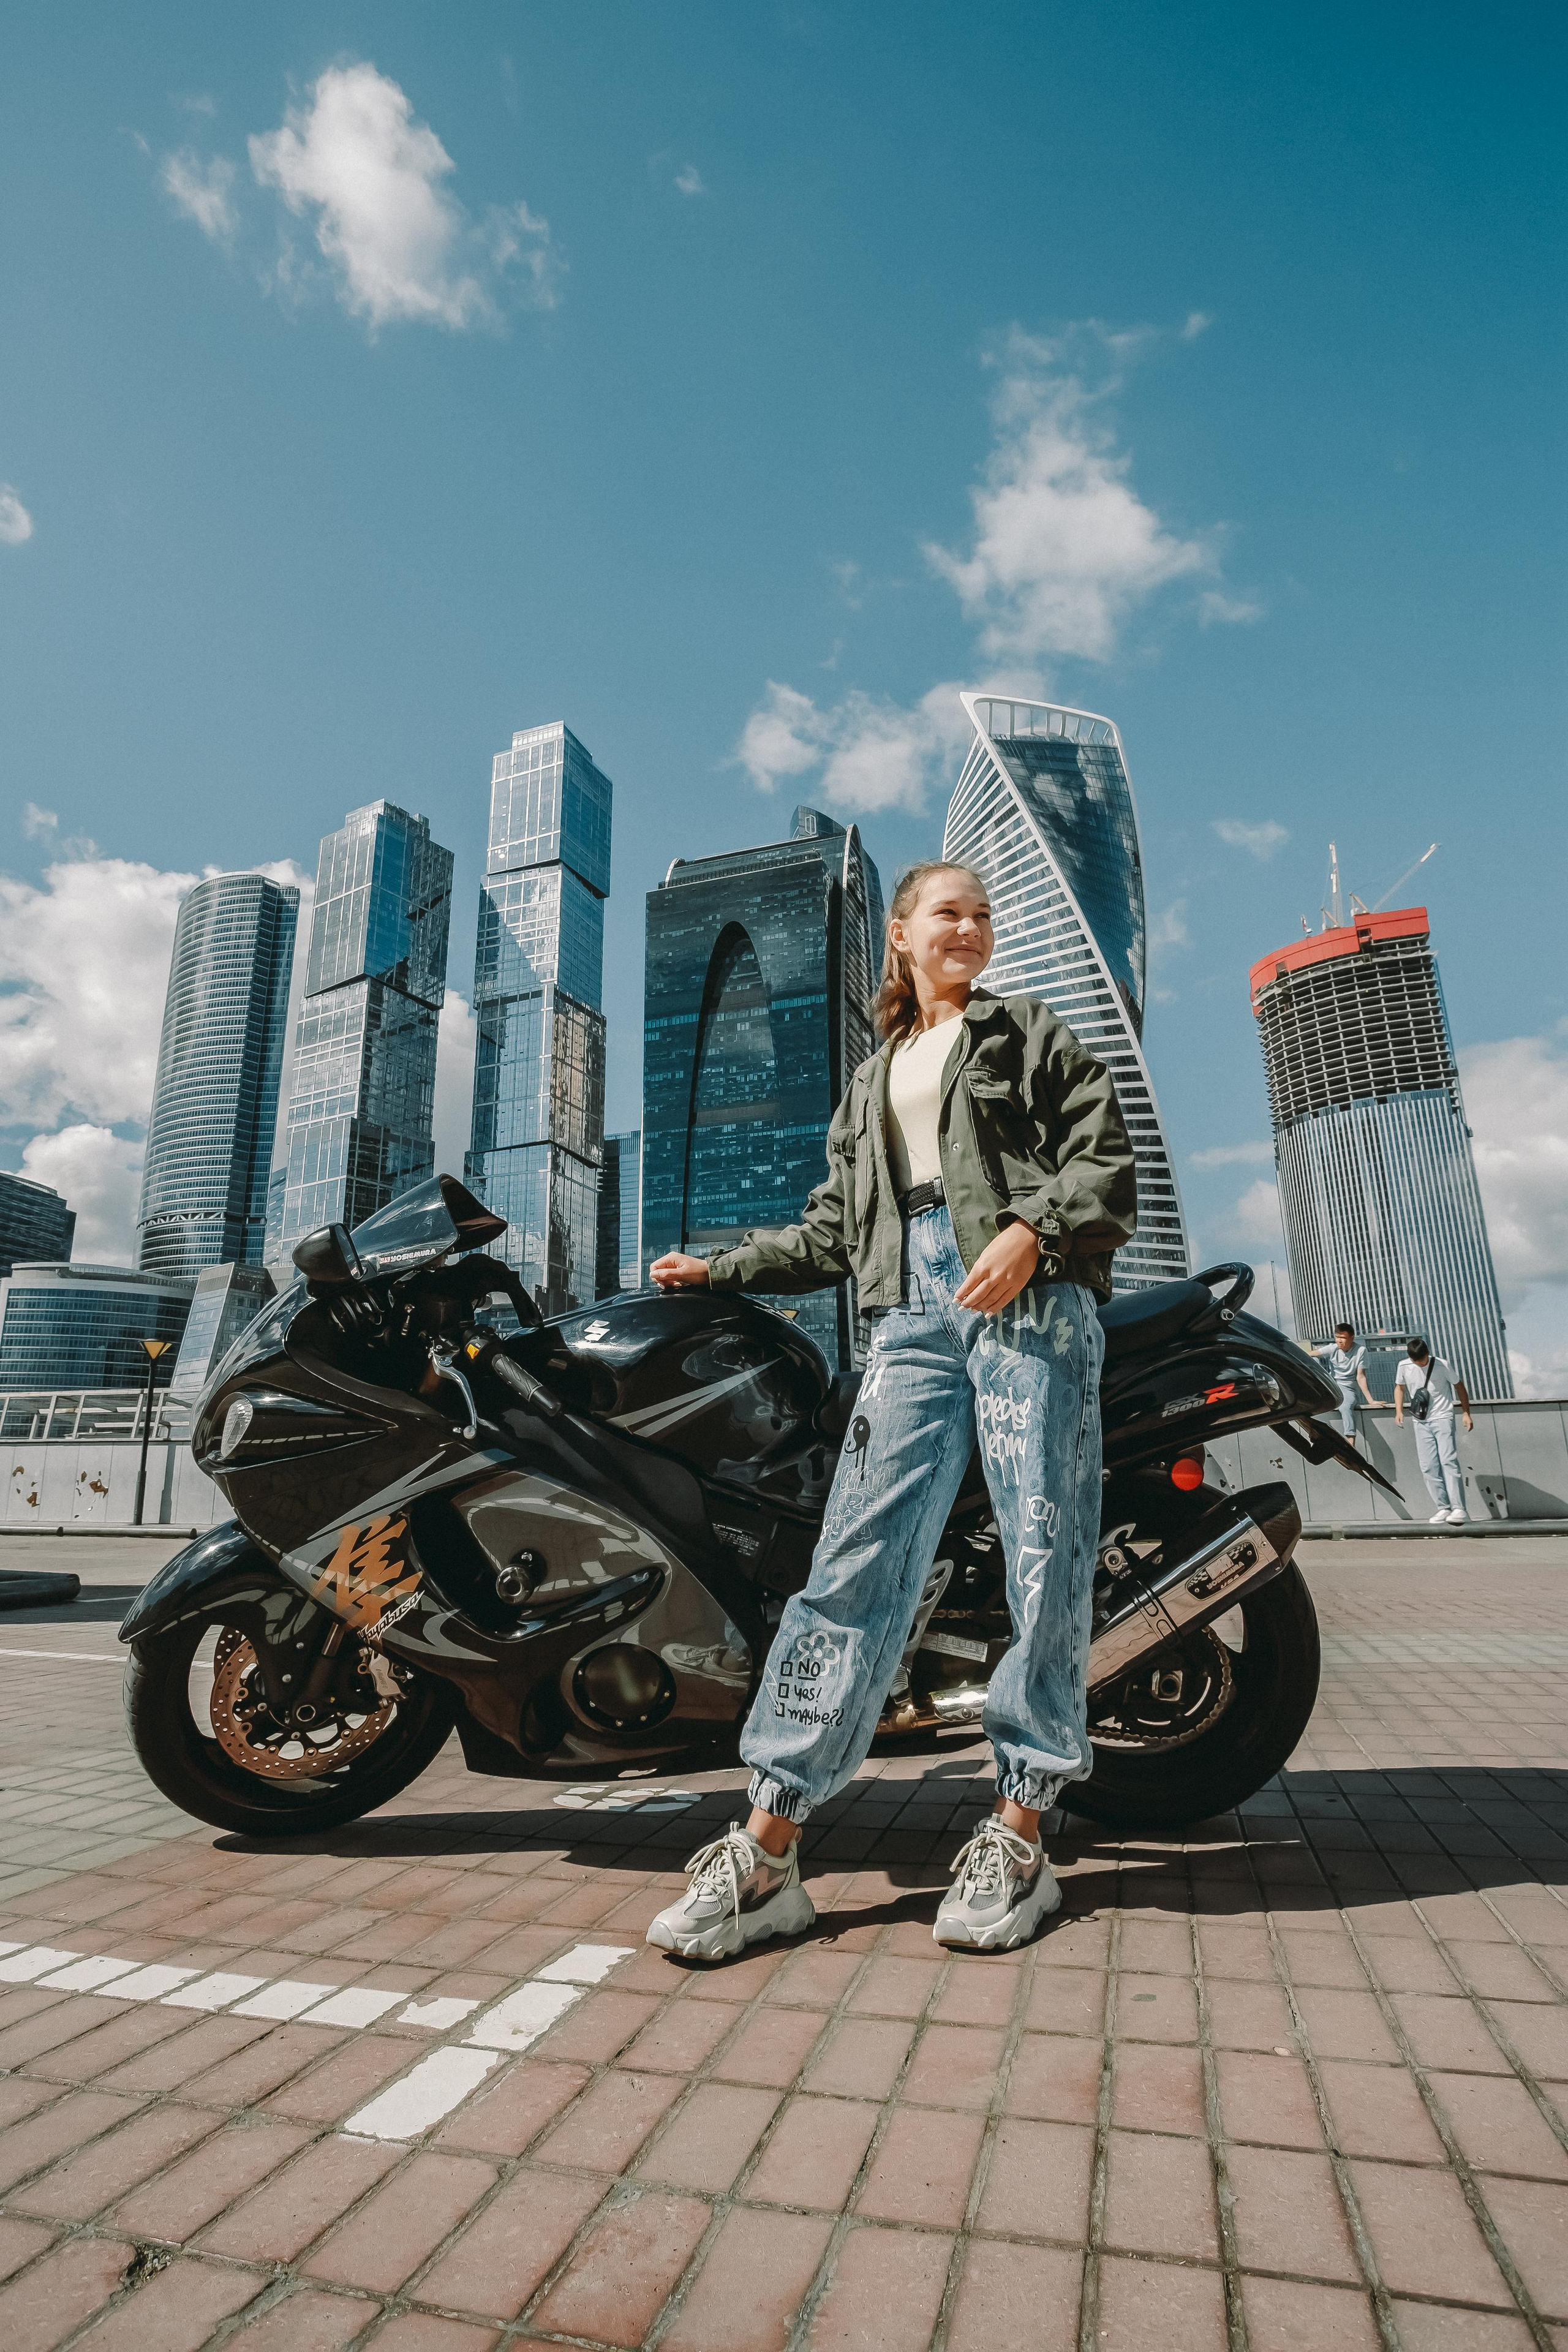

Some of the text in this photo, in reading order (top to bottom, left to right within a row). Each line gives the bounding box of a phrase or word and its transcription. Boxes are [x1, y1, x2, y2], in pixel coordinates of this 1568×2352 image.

[391, 1248, 437, 1262] YOSHIMURA
[1161, 1399, 1205, 1418] 1300
[797, 1658, 821, 1678] NO
[794, 1685, 822, 1703] yes!
